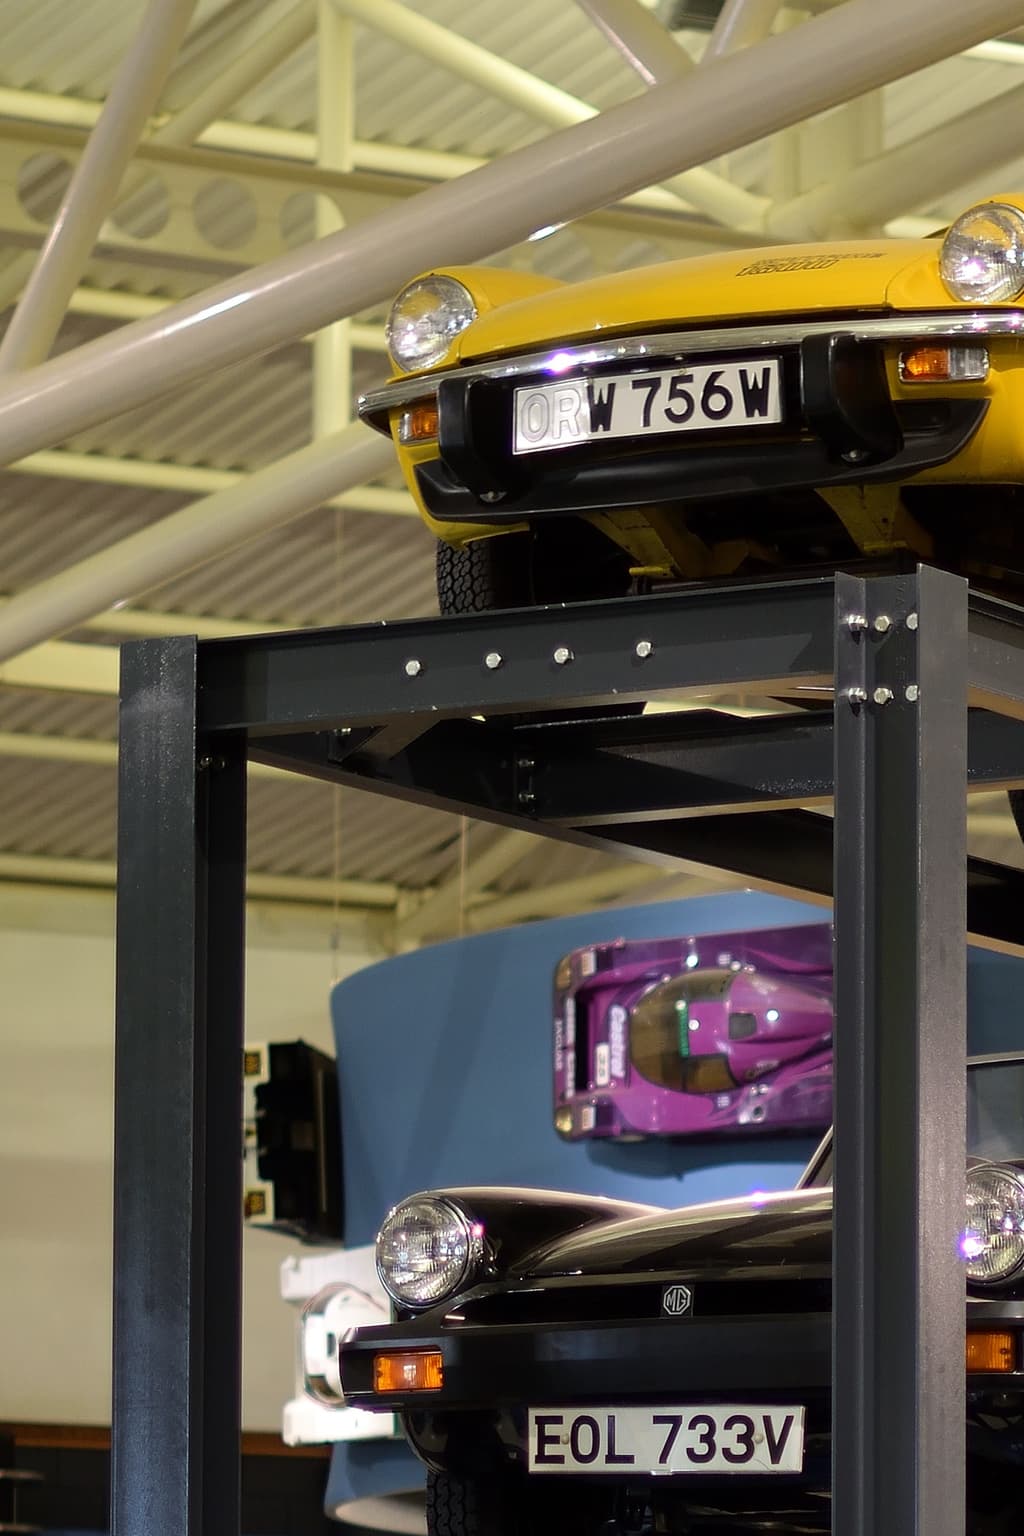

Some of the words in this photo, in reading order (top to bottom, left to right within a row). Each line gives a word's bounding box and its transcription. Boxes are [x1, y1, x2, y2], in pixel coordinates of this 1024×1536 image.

[521, 382, 617, 443] ORW
[632, 366, 772, 429] 756W
[609, 1005, 626, 1079] Castrol
[665, 1287, 689, 1313] MG
[534, 1414, 635, 1465] EOL
[652, 1414, 795, 1465] 733V
